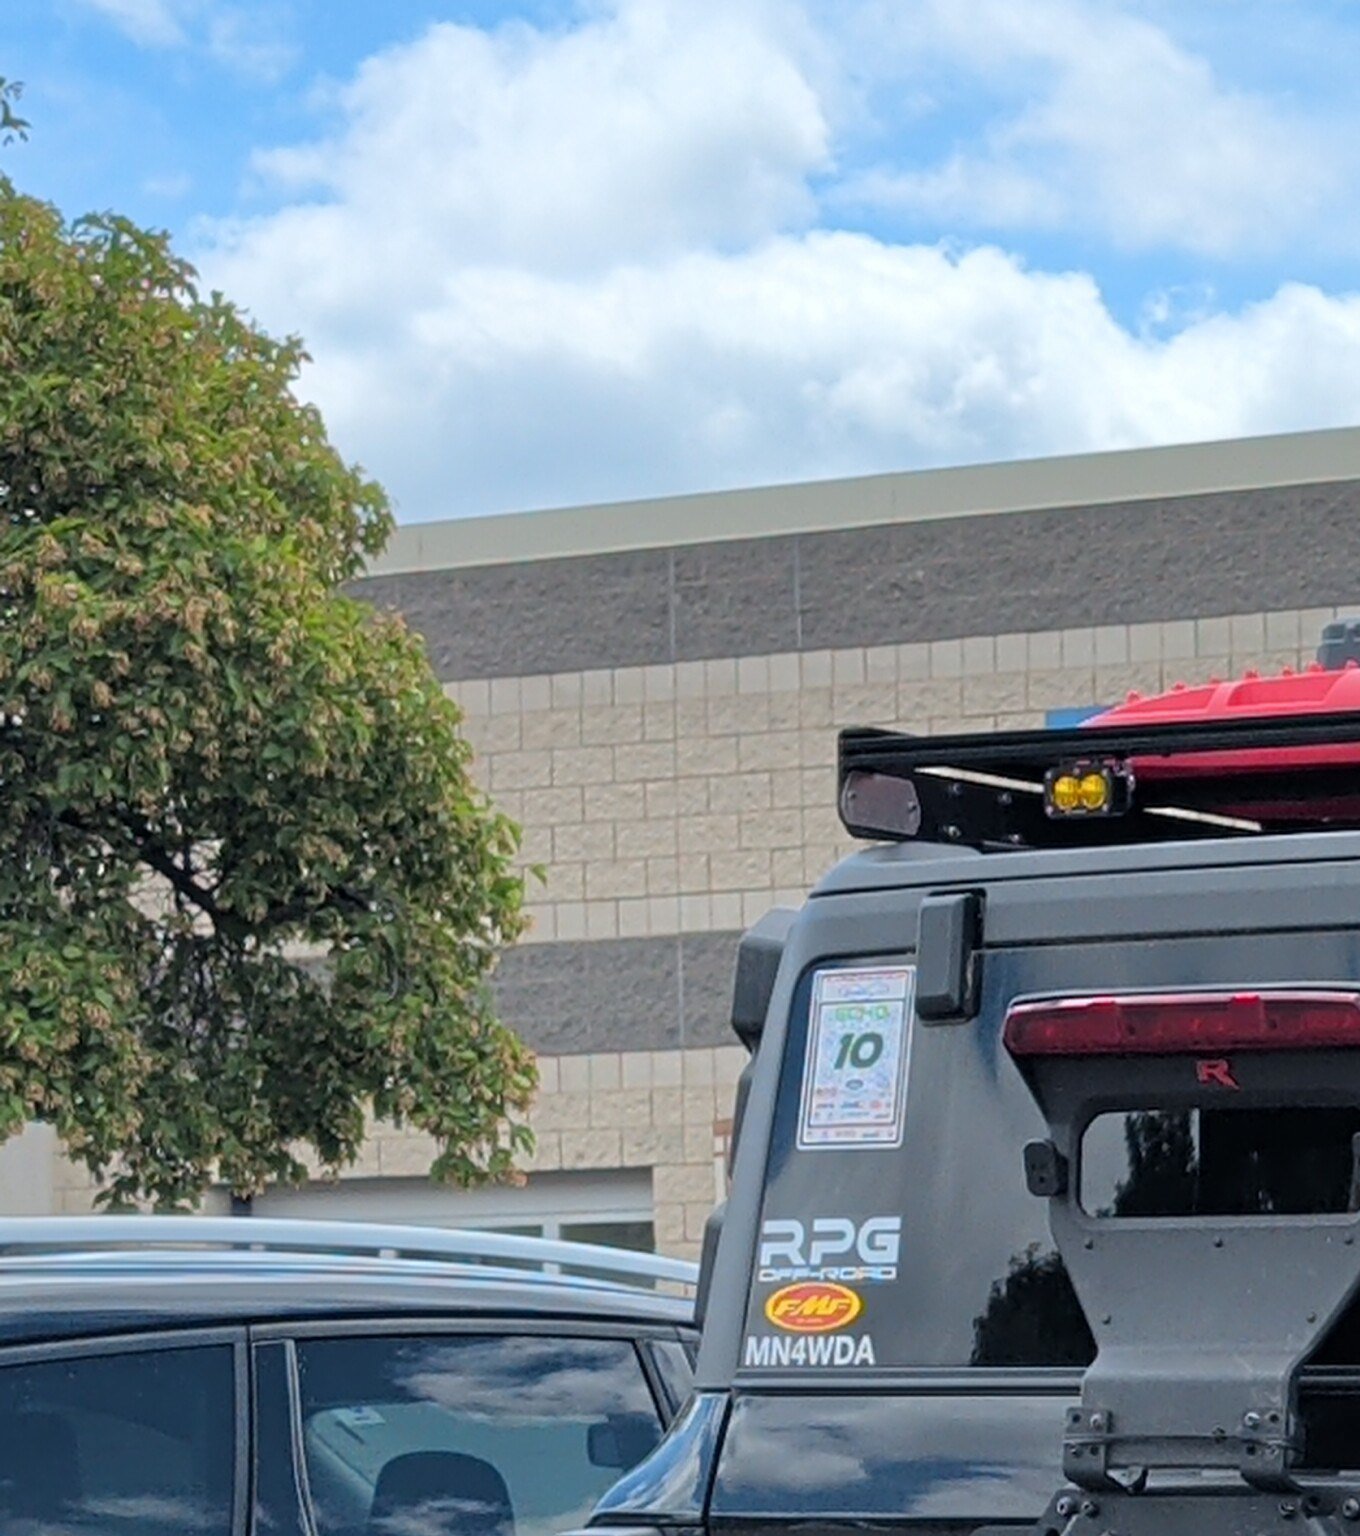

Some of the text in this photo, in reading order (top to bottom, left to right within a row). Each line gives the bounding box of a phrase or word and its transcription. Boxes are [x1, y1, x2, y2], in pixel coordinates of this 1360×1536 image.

[833, 1031, 885, 1070] 10
[1196, 1059, 1240, 1090] R
[760, 1216, 902, 1267] RPG
[758, 1266, 897, 1283] OFF-ROAD
[773, 1294, 852, 1317] FMF
[744, 1333, 877, 1367] MN4WDA
